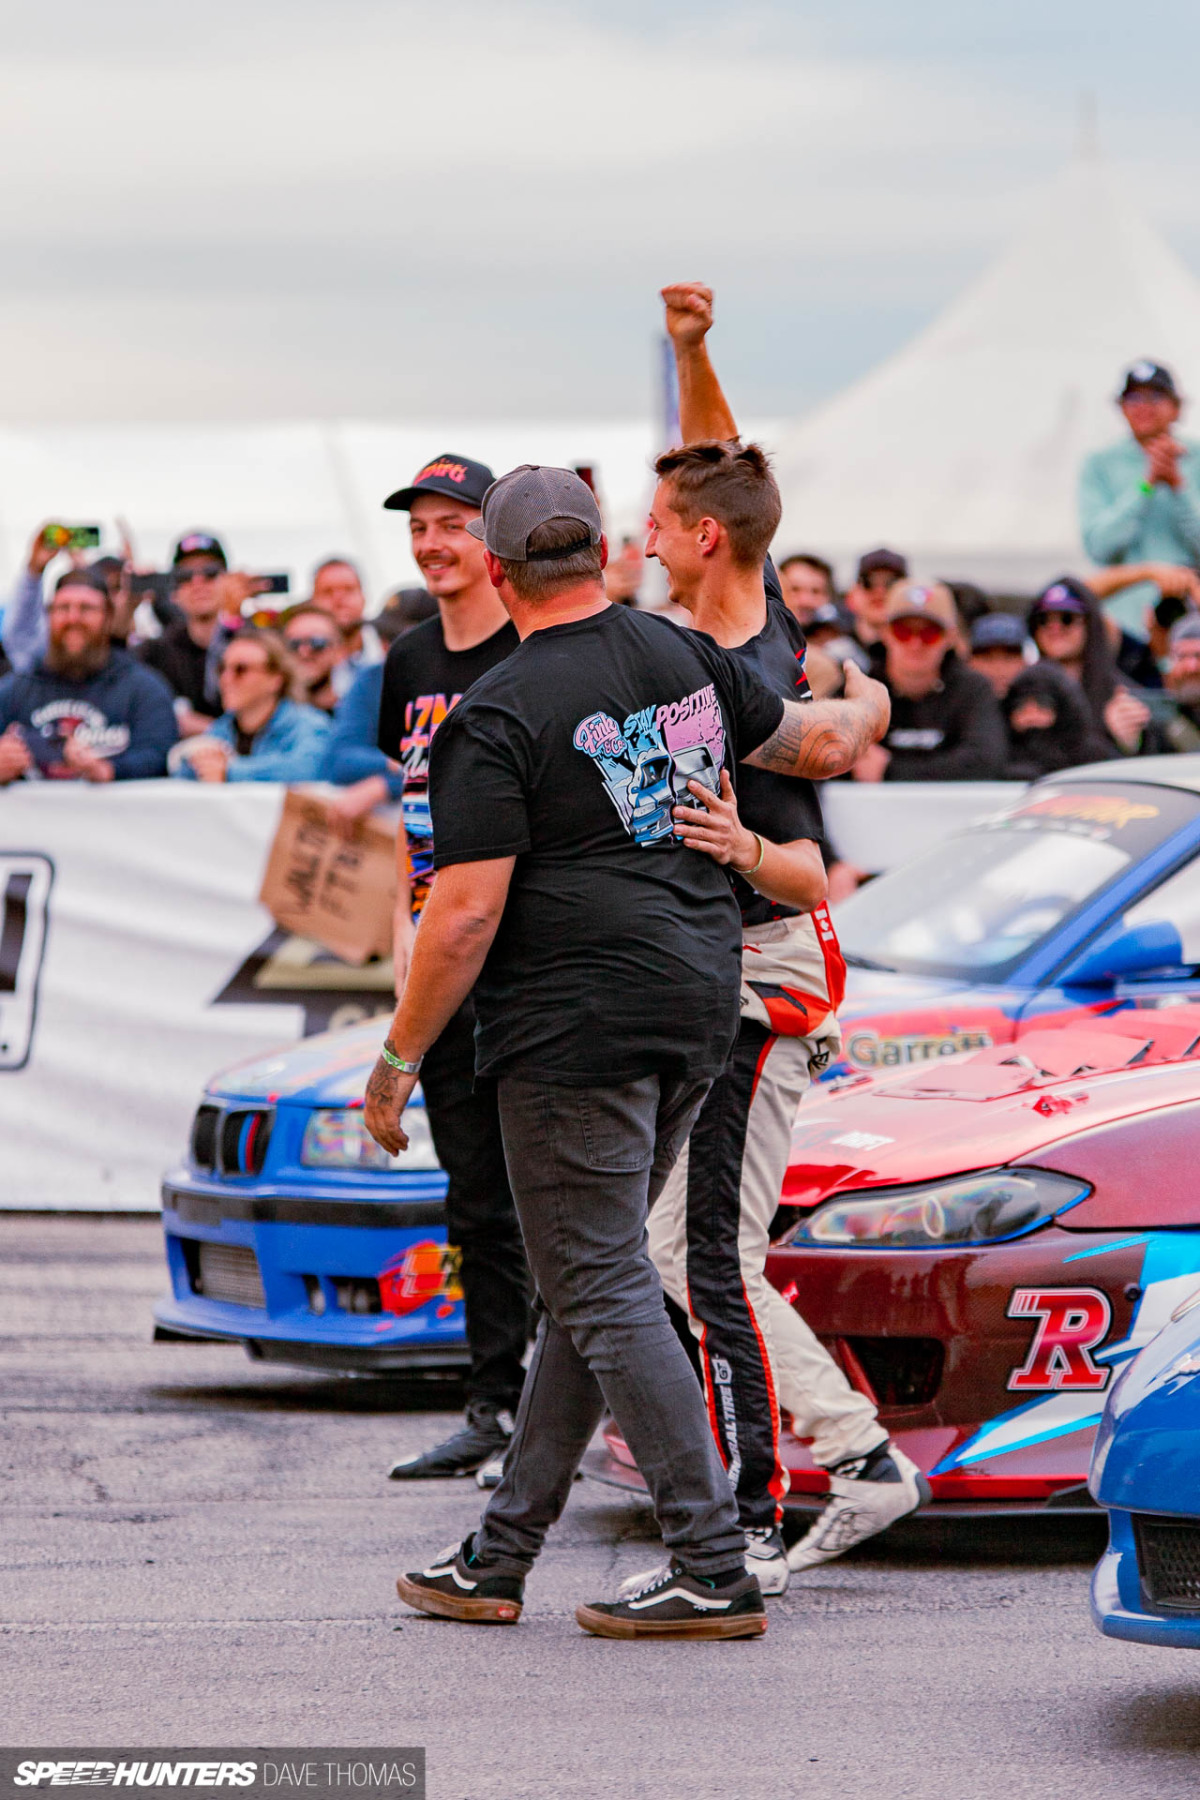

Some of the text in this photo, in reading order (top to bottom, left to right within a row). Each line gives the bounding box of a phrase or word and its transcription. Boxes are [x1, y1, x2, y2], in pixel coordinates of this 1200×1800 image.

[575, 712, 619, 753] Fink
[624, 682, 717, 738] STAY POSITIVE
[1006, 1287, 1112, 1391] R
[720, 1384, 736, 1421] TIRE
